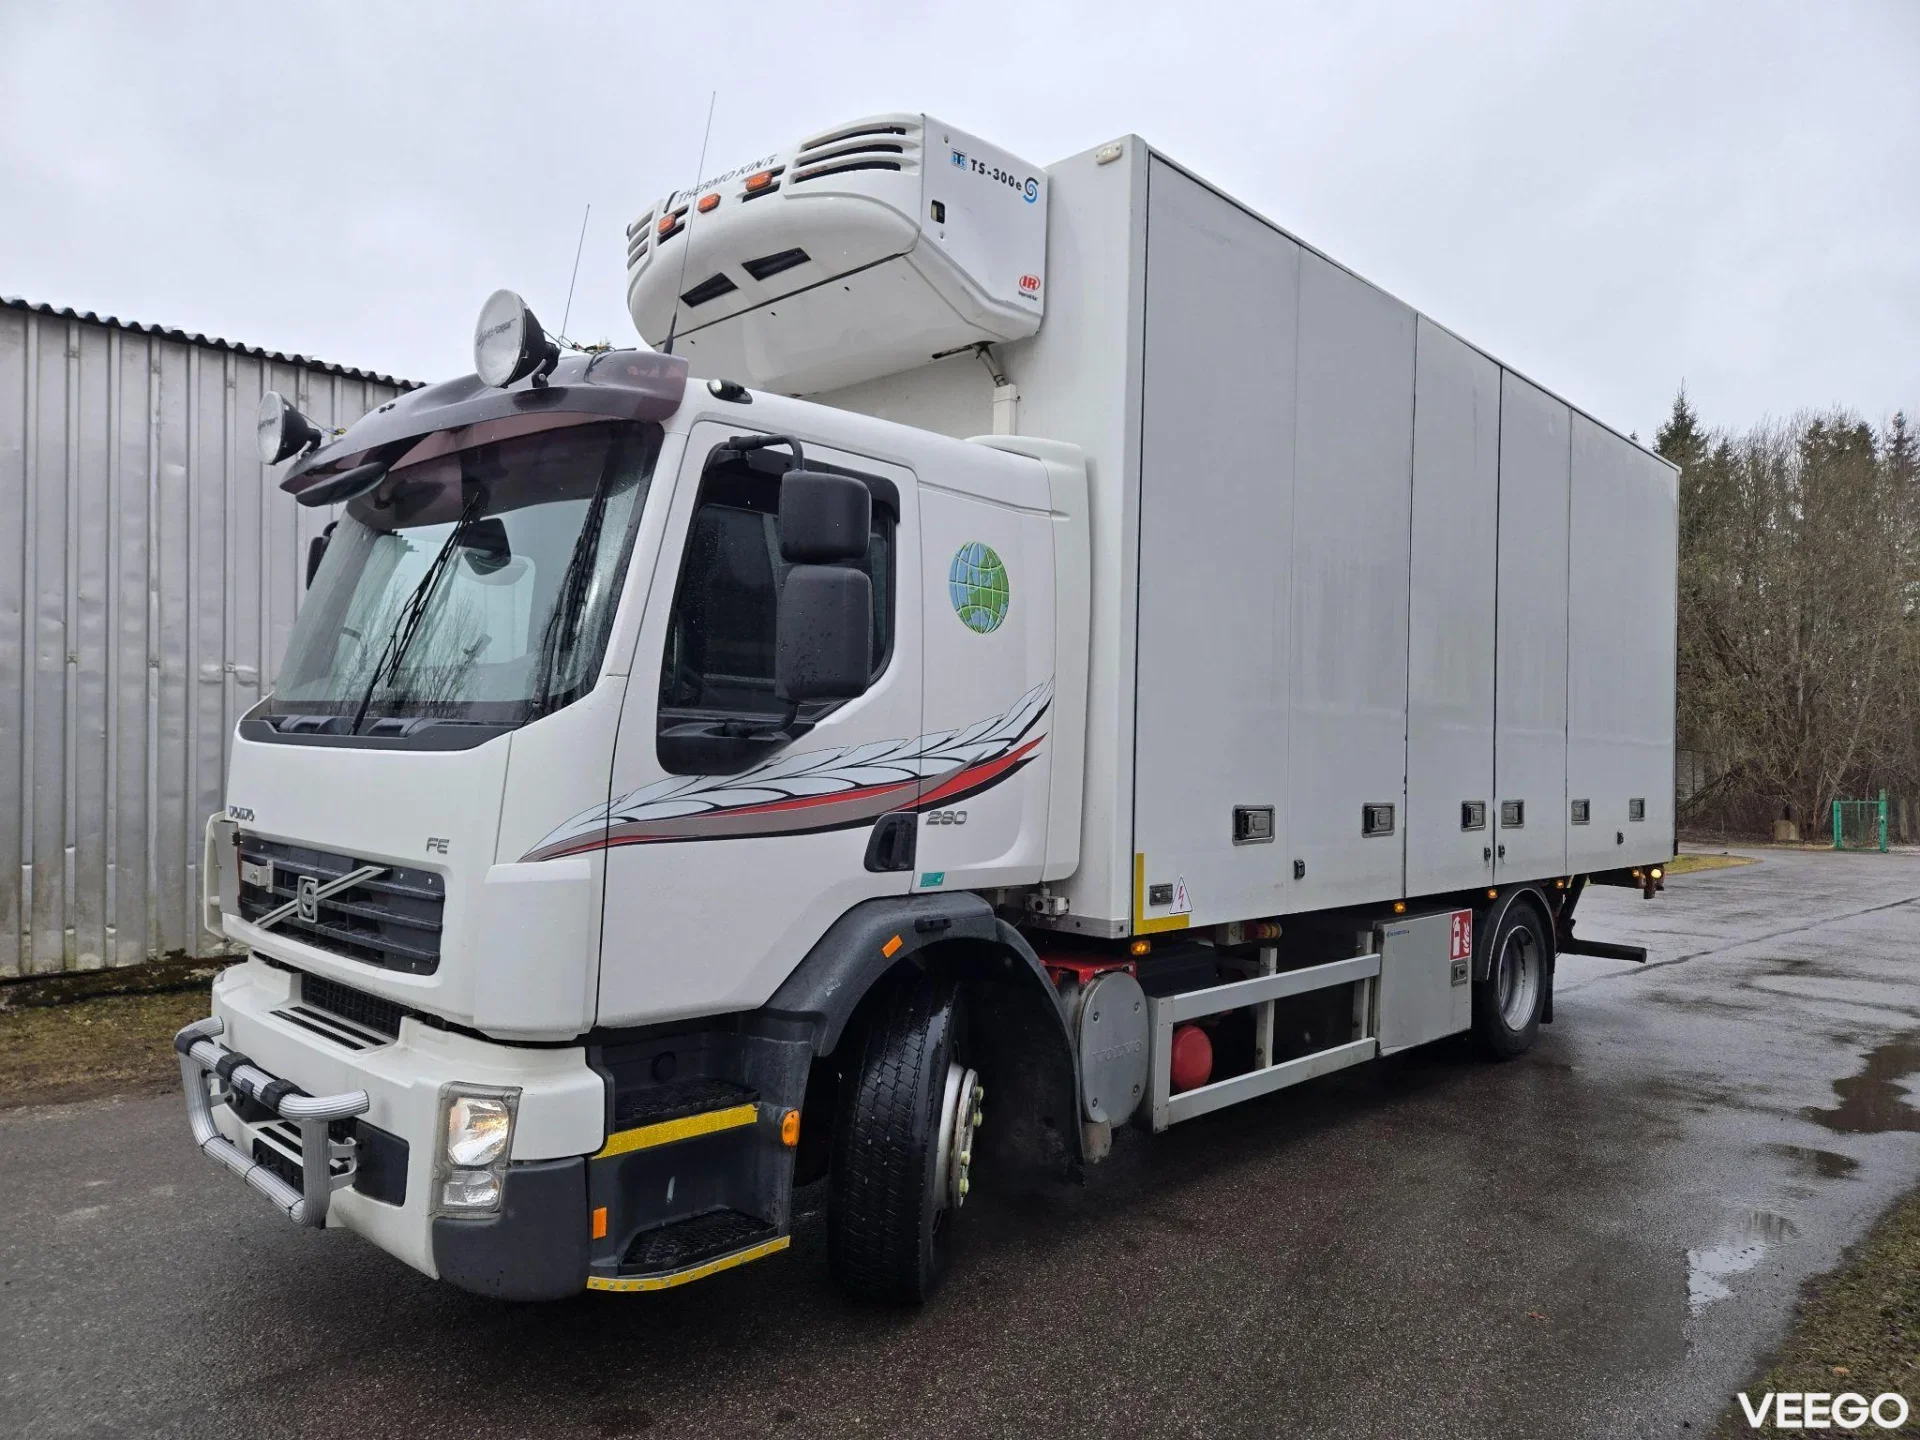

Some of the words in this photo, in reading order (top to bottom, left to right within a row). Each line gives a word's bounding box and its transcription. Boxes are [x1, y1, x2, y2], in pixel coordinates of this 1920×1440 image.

[678, 170, 736, 204] THERMO
[735, 153, 778, 177] KING
[970, 158, 1022, 191] TS-300e
[426, 837, 450, 854] FE
